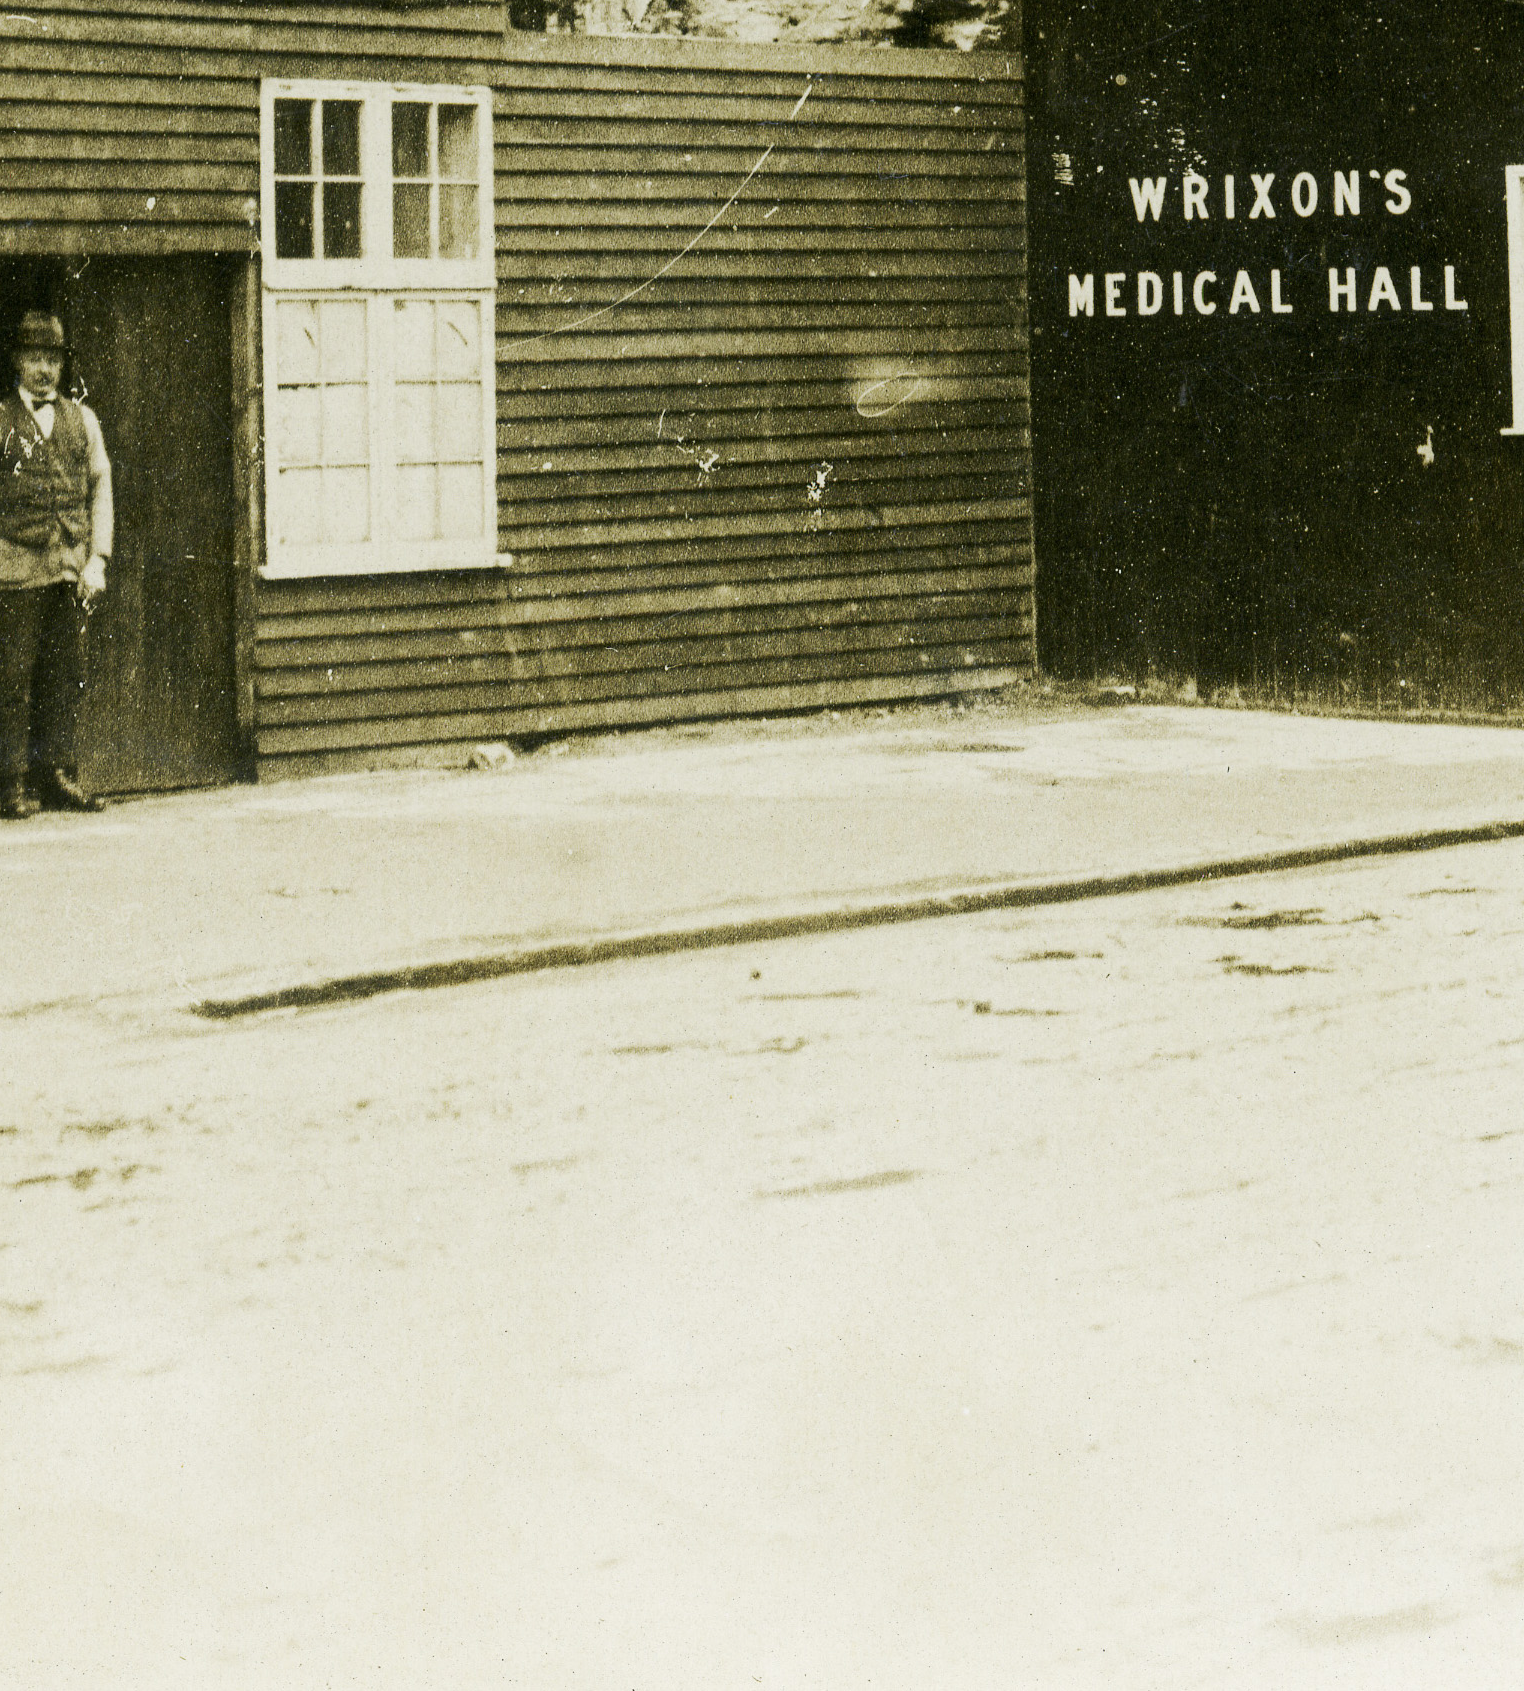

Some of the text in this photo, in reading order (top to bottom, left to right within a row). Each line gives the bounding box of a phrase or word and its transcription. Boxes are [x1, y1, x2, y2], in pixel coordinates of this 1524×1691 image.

[1128, 168, 1412, 223] WRIXON'S
[1068, 265, 1469, 318] MEDICAL HALL
